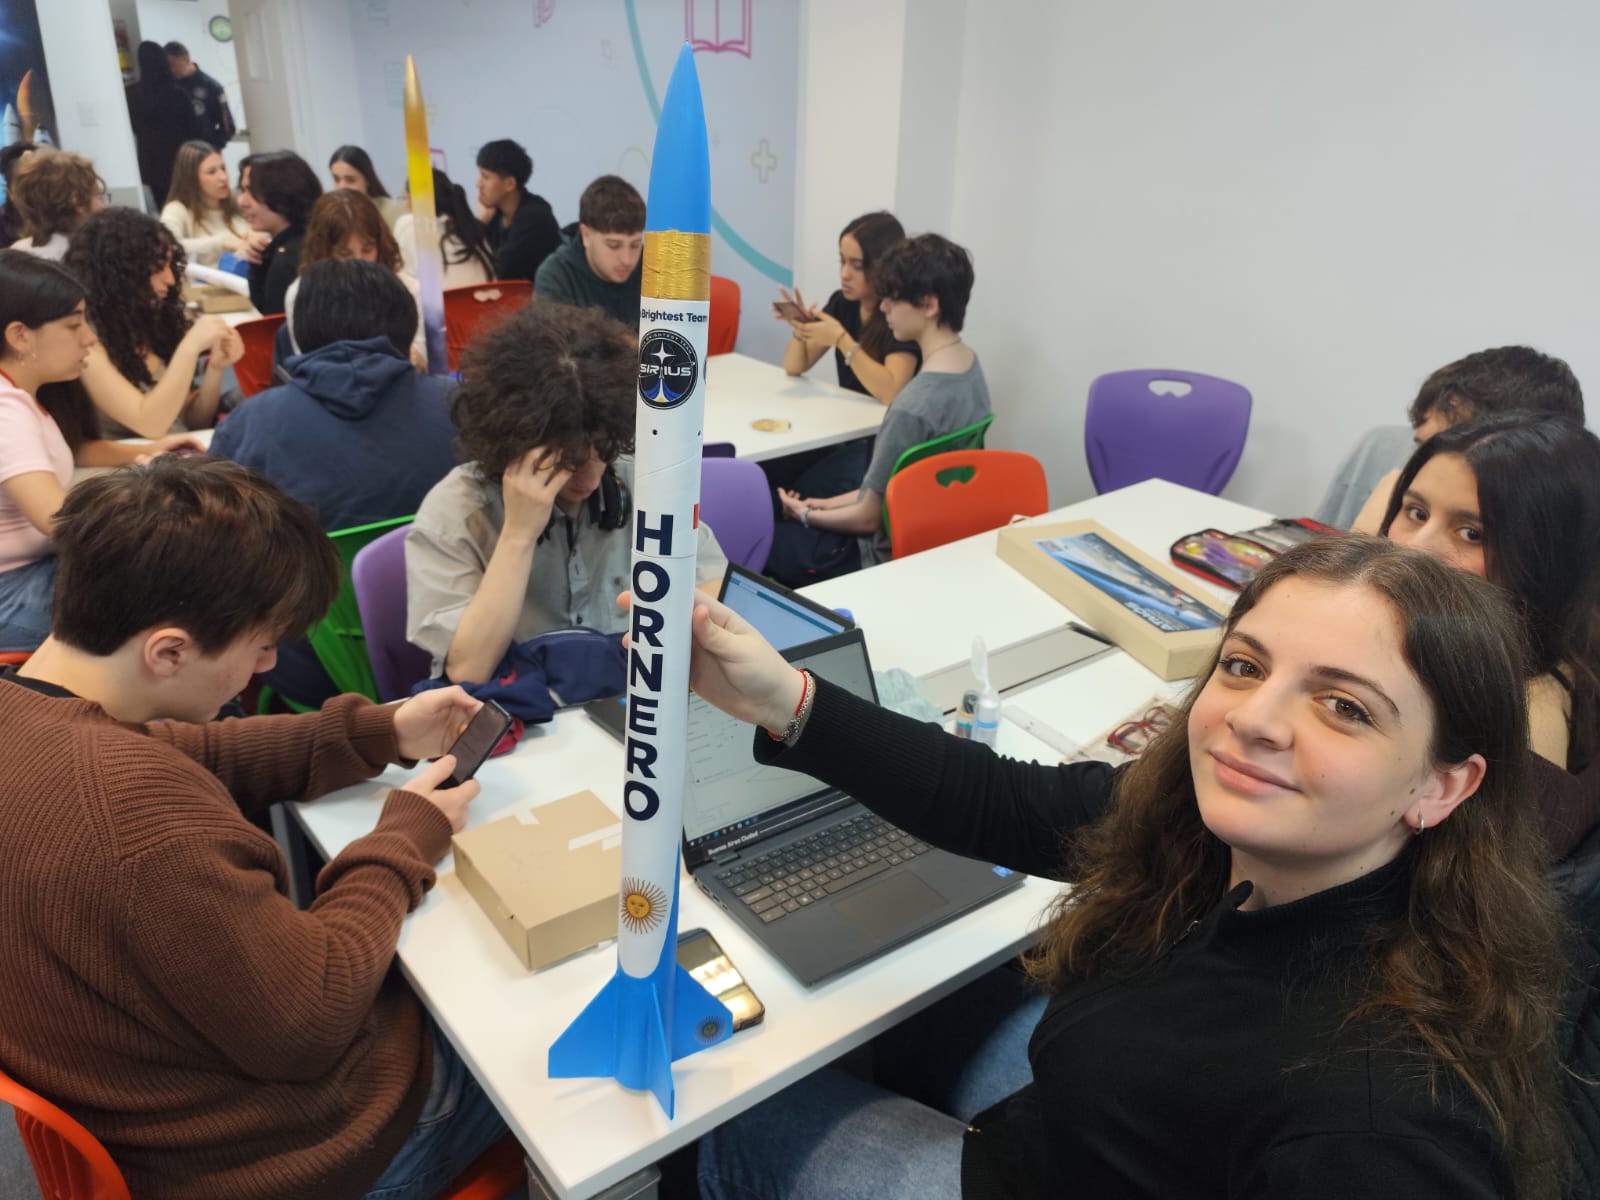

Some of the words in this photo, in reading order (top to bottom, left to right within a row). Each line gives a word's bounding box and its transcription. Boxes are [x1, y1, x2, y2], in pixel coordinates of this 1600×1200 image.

[641, 308, 684, 322] Brightest
[640, 363, 692, 377] SIRIUS
[623, 509, 674, 821] HORNERO
